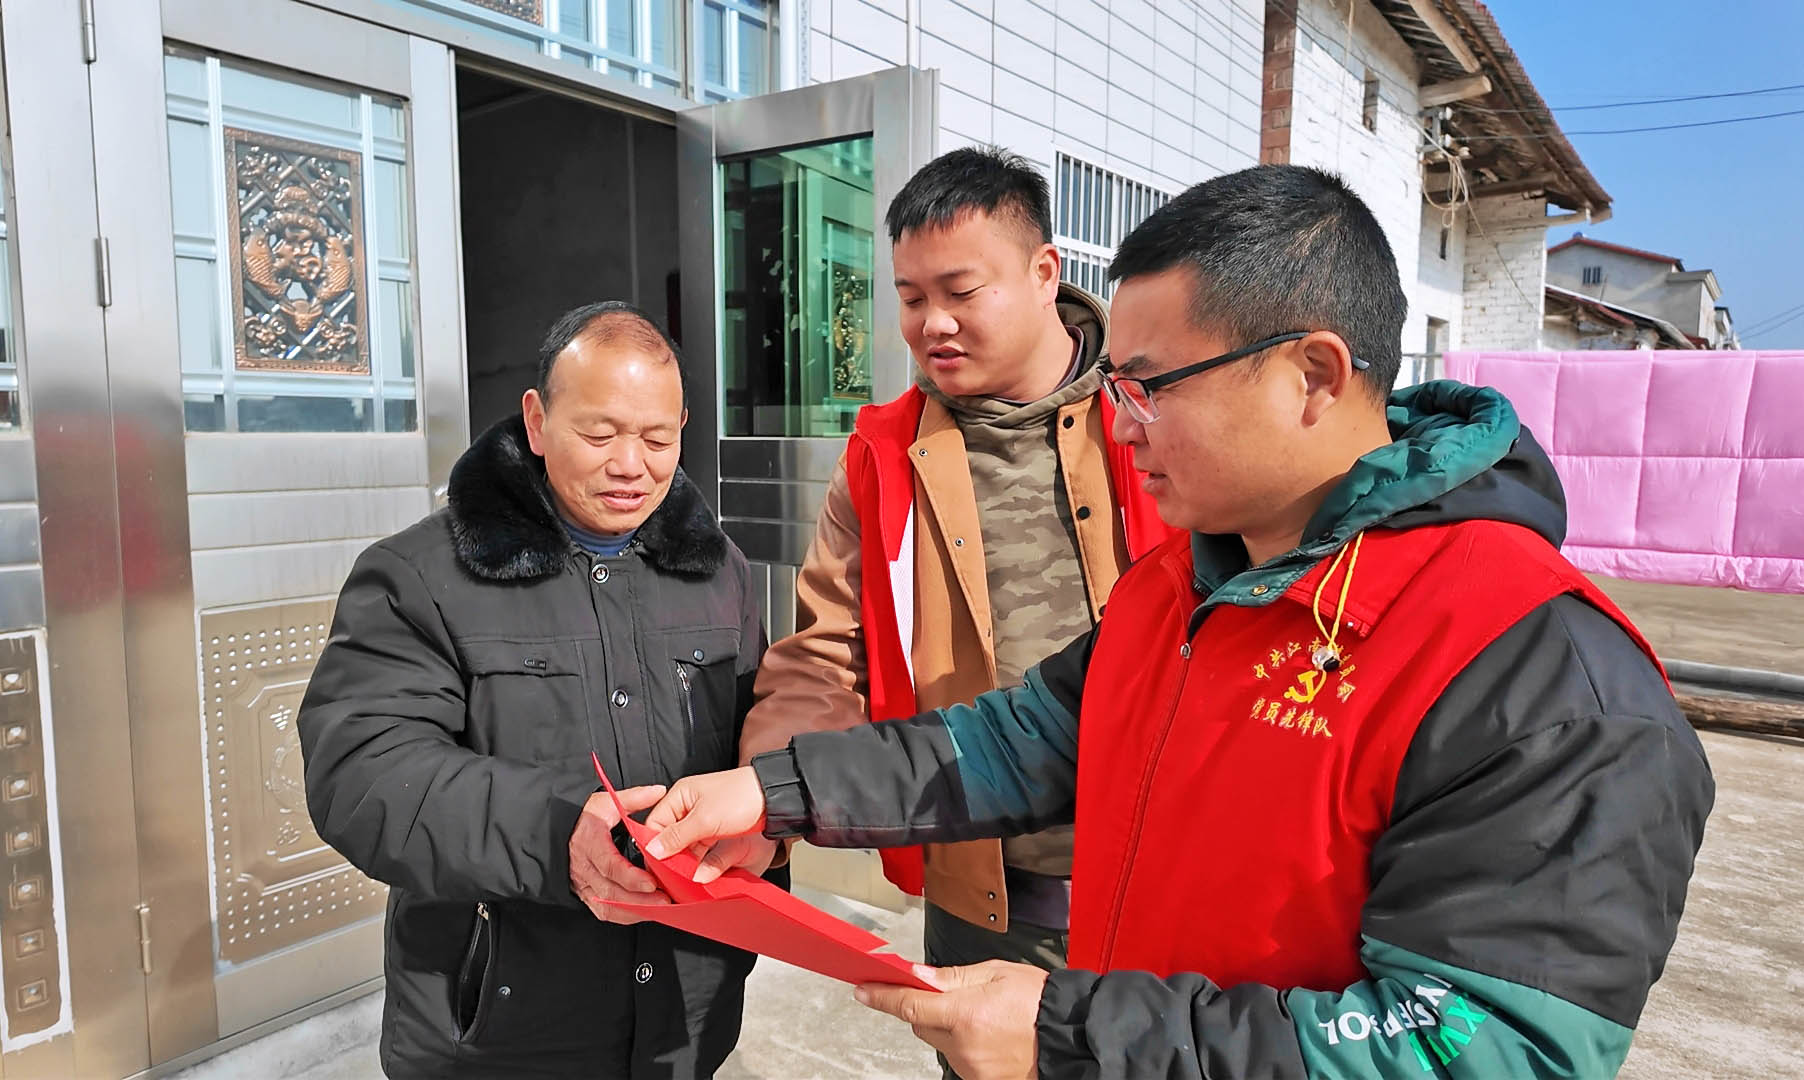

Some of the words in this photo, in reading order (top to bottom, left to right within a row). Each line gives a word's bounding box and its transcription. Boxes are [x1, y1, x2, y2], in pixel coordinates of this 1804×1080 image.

[1249, 697, 1333, 737] 党员先锋队
